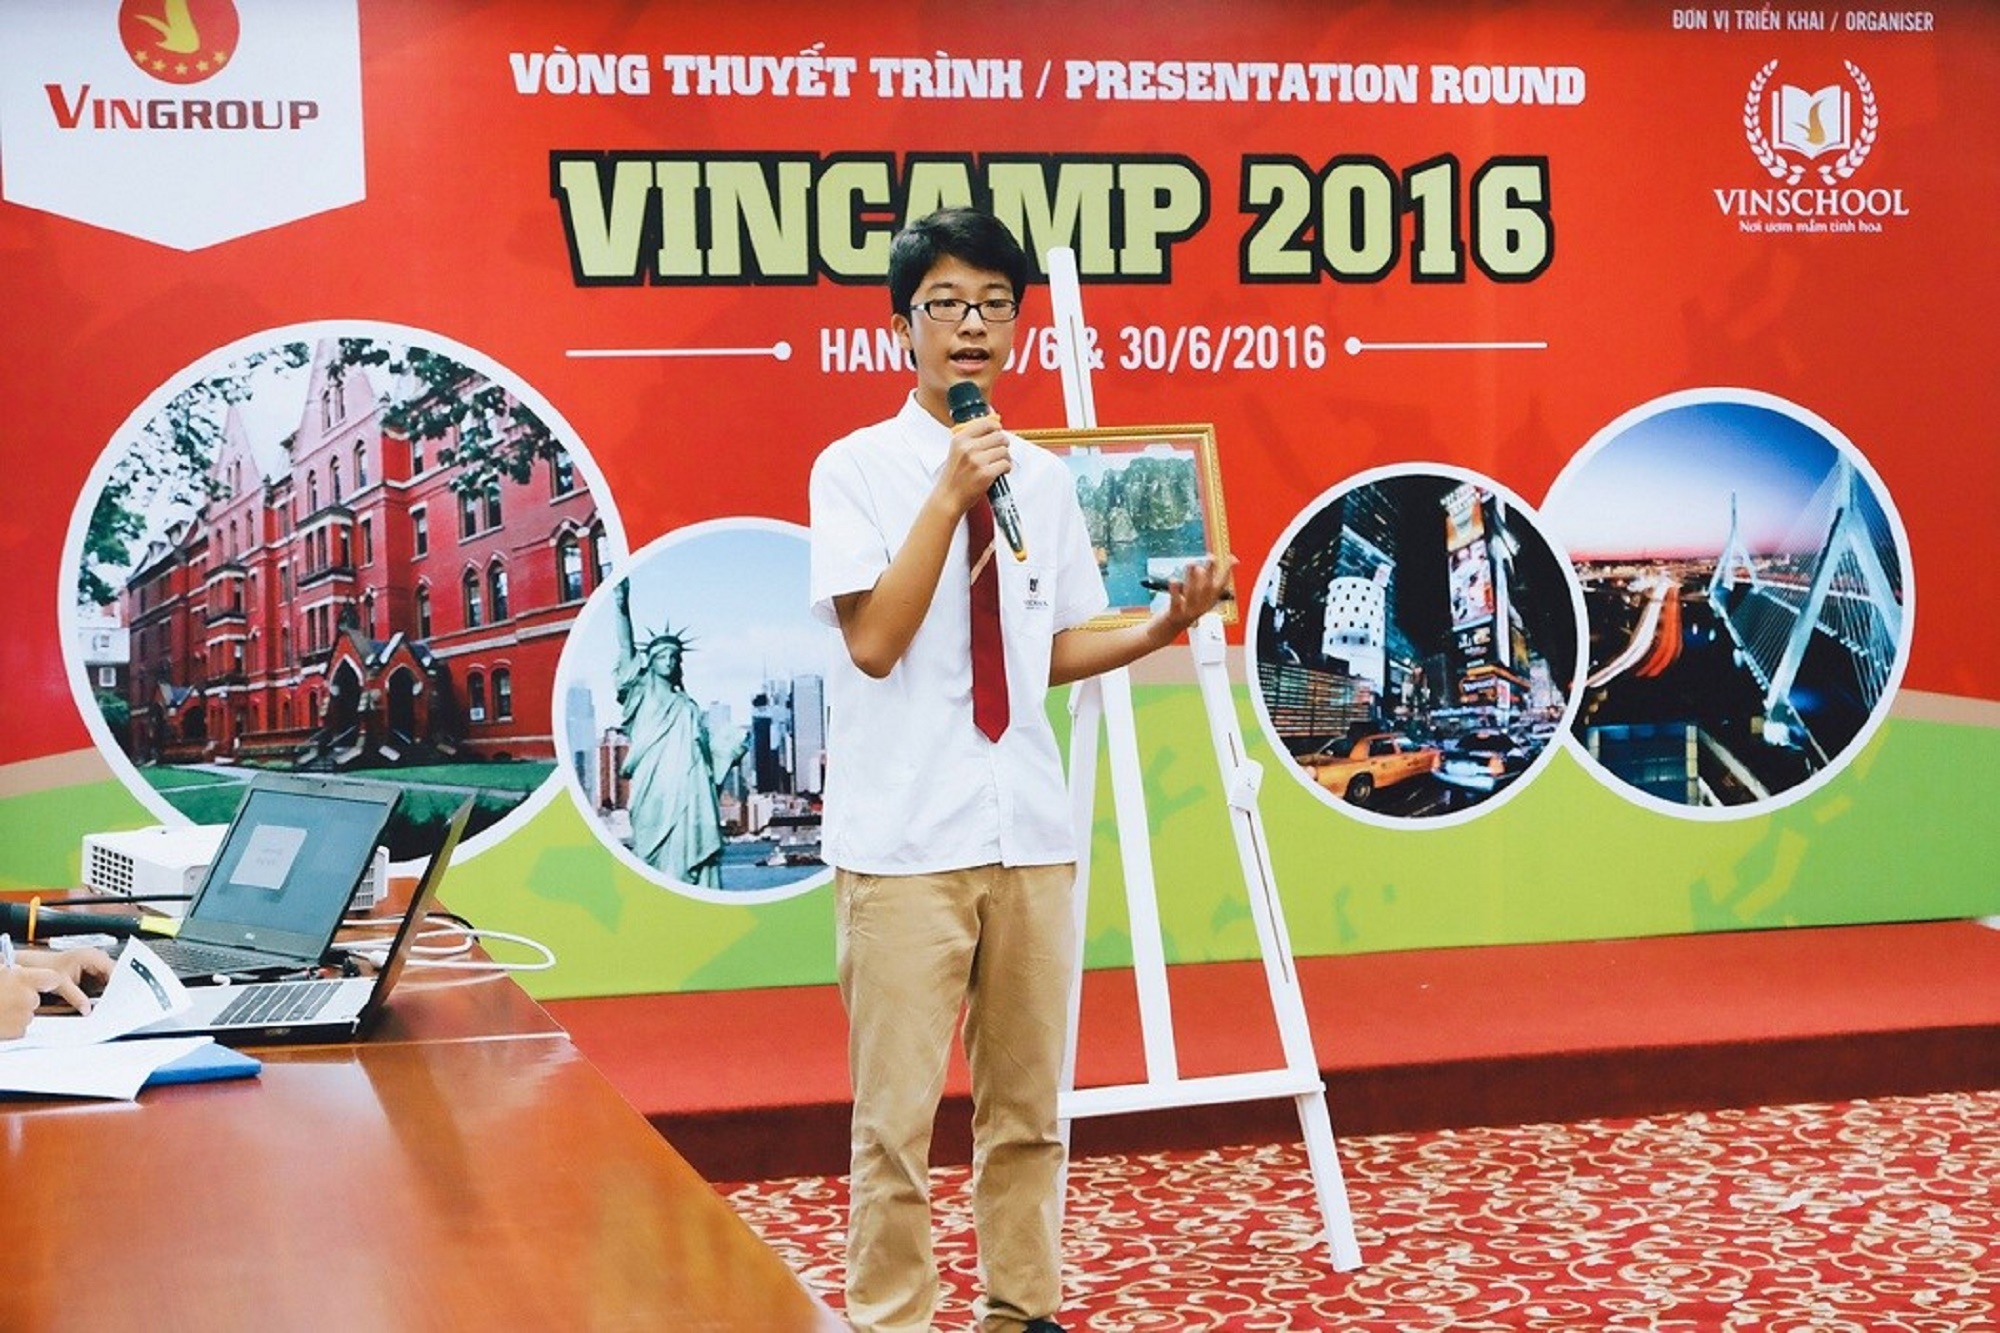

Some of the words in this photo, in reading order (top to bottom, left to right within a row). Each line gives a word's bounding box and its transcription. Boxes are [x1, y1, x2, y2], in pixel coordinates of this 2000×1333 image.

[1713, 10, 1730, 33] VỊ
[1735, 2, 1781, 31] TRIỂN
[1787, 10, 1825, 31] KHAI
[1830, 12, 1839, 32] /
[1845, 11, 1935, 32] ORGANISER
[510, 46, 650, 95] VÒNG
[663, 42, 858, 97] THUYẾT
[869, 51, 1024, 100] TRÌNH
[1035, 59, 1052, 99] /
[1065, 60, 1419, 104] PRESENTATION
[1430, 64, 1586, 105] ROUND
[44, 84, 319, 130] VINGROUP
[1244, 157, 1551, 280] 2016
[1713, 188, 1910, 216] VINSCHOOL
[1858, 219, 1883, 233] hoa
[1119, 324, 1327, 374] 30/6/2016
